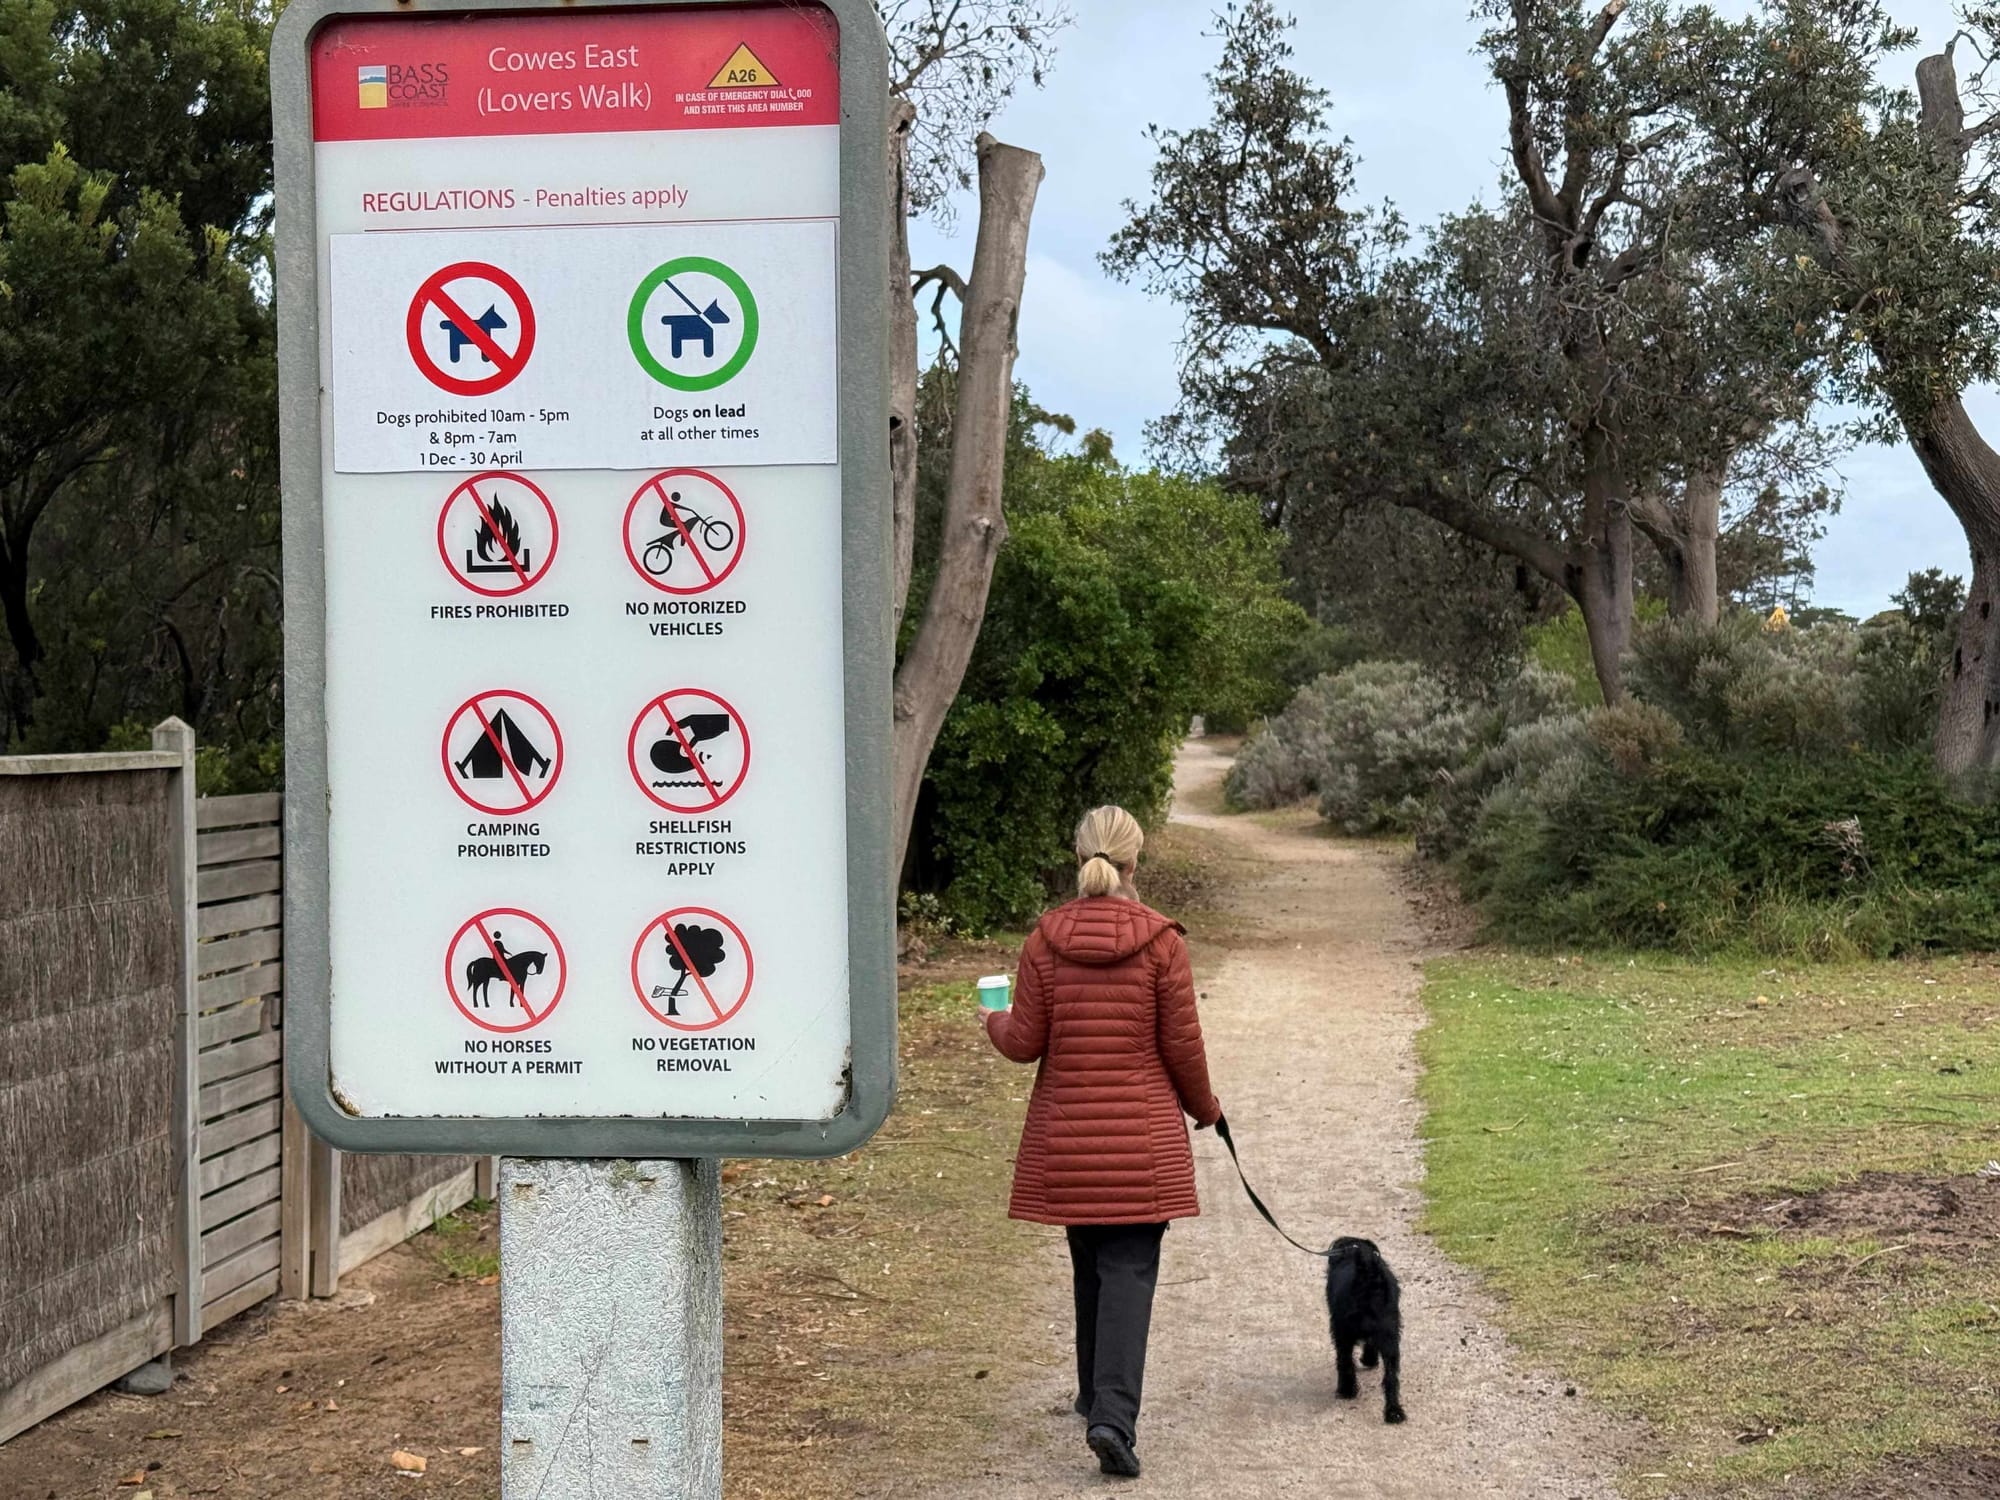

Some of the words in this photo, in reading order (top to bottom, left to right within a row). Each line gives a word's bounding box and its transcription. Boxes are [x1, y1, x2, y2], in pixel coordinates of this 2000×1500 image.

[489, 48, 576, 72] Cowes
[586, 44, 638, 68] East
[389, 63, 449, 84] BASS
[727, 69, 756, 83] A26
[389, 83, 448, 99] COAST
[676, 94, 683, 102] IN
[686, 93, 706, 102] CASE
[708, 93, 719, 101] OF
[720, 91, 768, 100] EMERGENCY
[771, 90, 788, 98] DIAL
[797, 89, 811, 98] 000
[478, 88, 571, 116] (Lovers
[579, 83, 651, 110] Walk)
[684, 106, 701, 114] AND
[702, 105, 725, 114] STATE
[727, 104, 745, 112] THIS
[747, 103, 768, 112] AREA
[770, 102, 803, 111] NUMBER
[363, 189, 515, 212] REGULATIONS
[537, 187, 625, 207] Penalties
[632, 185, 688, 209] apply
[377, 412, 410, 427] Dogs
[416, 409, 486, 427] prohibited
[491, 410, 525, 422] 10am
[540, 409, 569, 425] 5pm
[654, 407, 688, 422] Dogs
[693, 409, 710, 418] on
[716, 404, 745, 417] lead
[430, 432, 439, 444] &
[445, 432, 474, 447] 8pm
[488, 431, 516, 443] 7am
[641, 430, 654, 440] at
[659, 427, 673, 440] all
[678, 426, 716, 439] other
[721, 428, 759, 438] times
[421, 453, 424, 465] 1
[430, 453, 456, 465] Dec
[470, 452, 485, 464] 30
[490, 451, 522, 467] April
[432, 606, 471, 618] FIRES
[477, 605, 569, 618] PROHIBITED
[626, 603, 649, 615] NO
[654, 601, 746, 614] MOTORIZED
[649, 623, 722, 635] VEHICLES
[468, 823, 539, 836] CAMPING
[650, 821, 731, 833] SHELLFISH
[458, 844, 550, 857] PROHIBITED
[636, 842, 745, 854] RESTRICTIONS
[668, 863, 715, 875] APPLY
[465, 1041, 487, 1052] NO
[492, 1041, 551, 1053] HORSES
[633, 1038, 655, 1050] NO
[659, 1038, 754, 1050] VEGETATION
[435, 1061, 507, 1073] WITHOUT
[512, 1062, 521, 1073] A
[527, 1061, 582, 1073] PERMIT
[657, 1059, 731, 1071] REMOVAL
